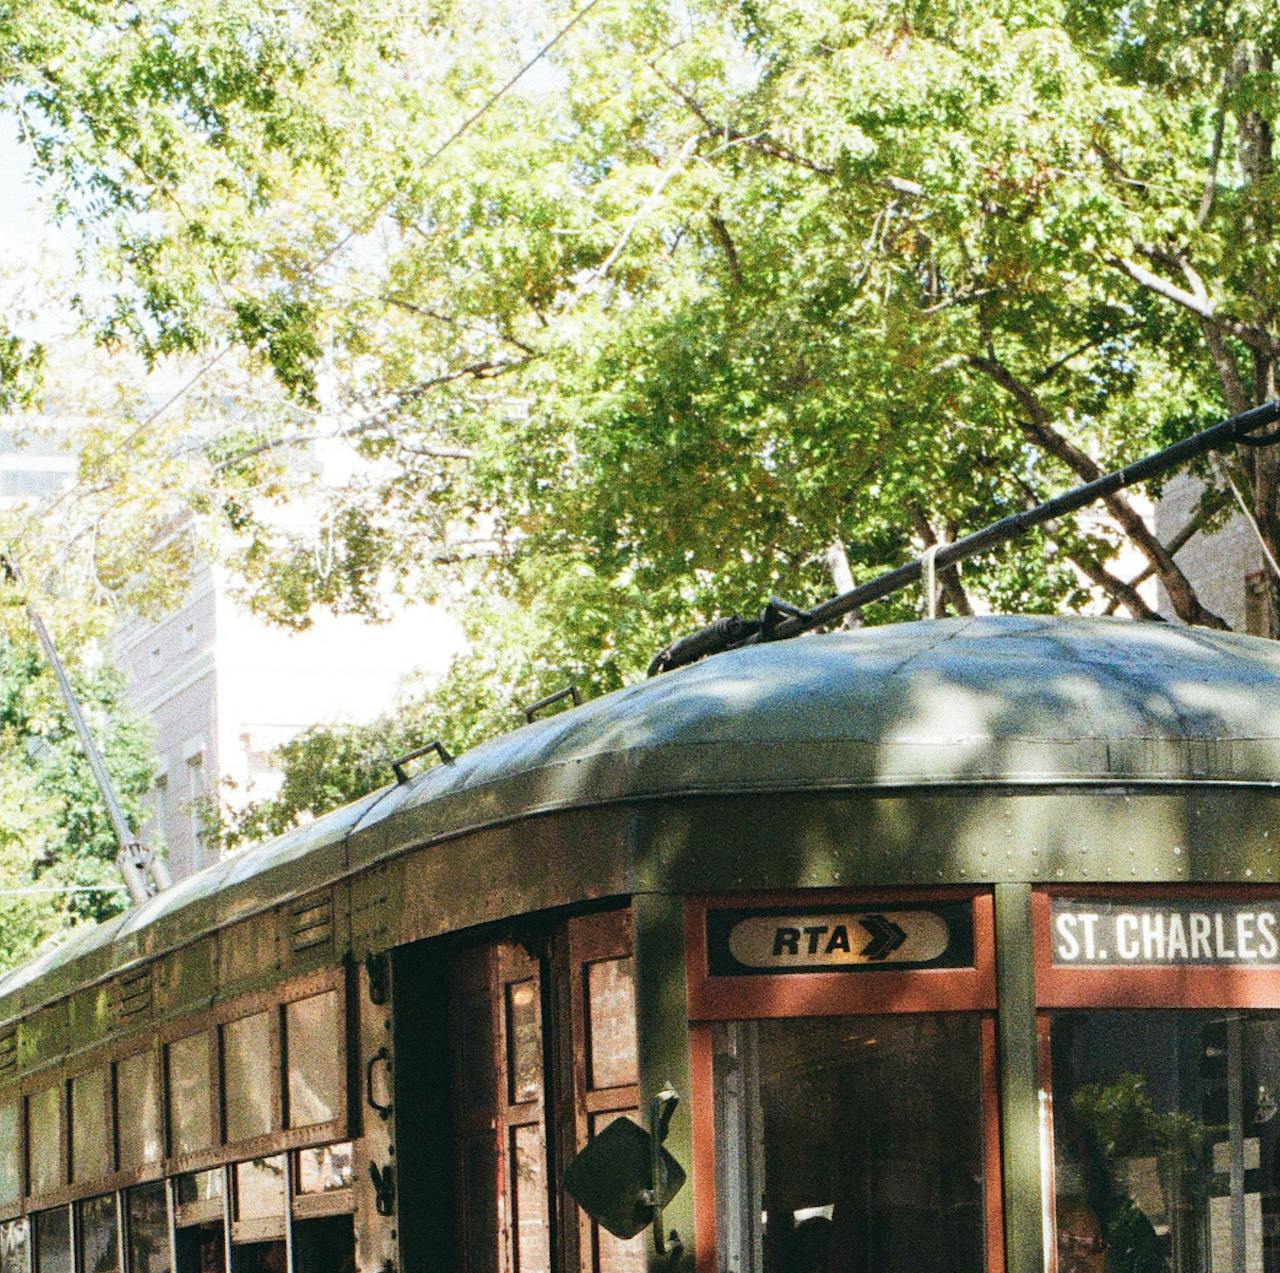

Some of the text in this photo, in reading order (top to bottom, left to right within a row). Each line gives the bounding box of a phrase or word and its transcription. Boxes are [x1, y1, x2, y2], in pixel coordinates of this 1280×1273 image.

[773, 924, 851, 955] RTA
[1055, 911, 1279, 960] ST. CHARLES
